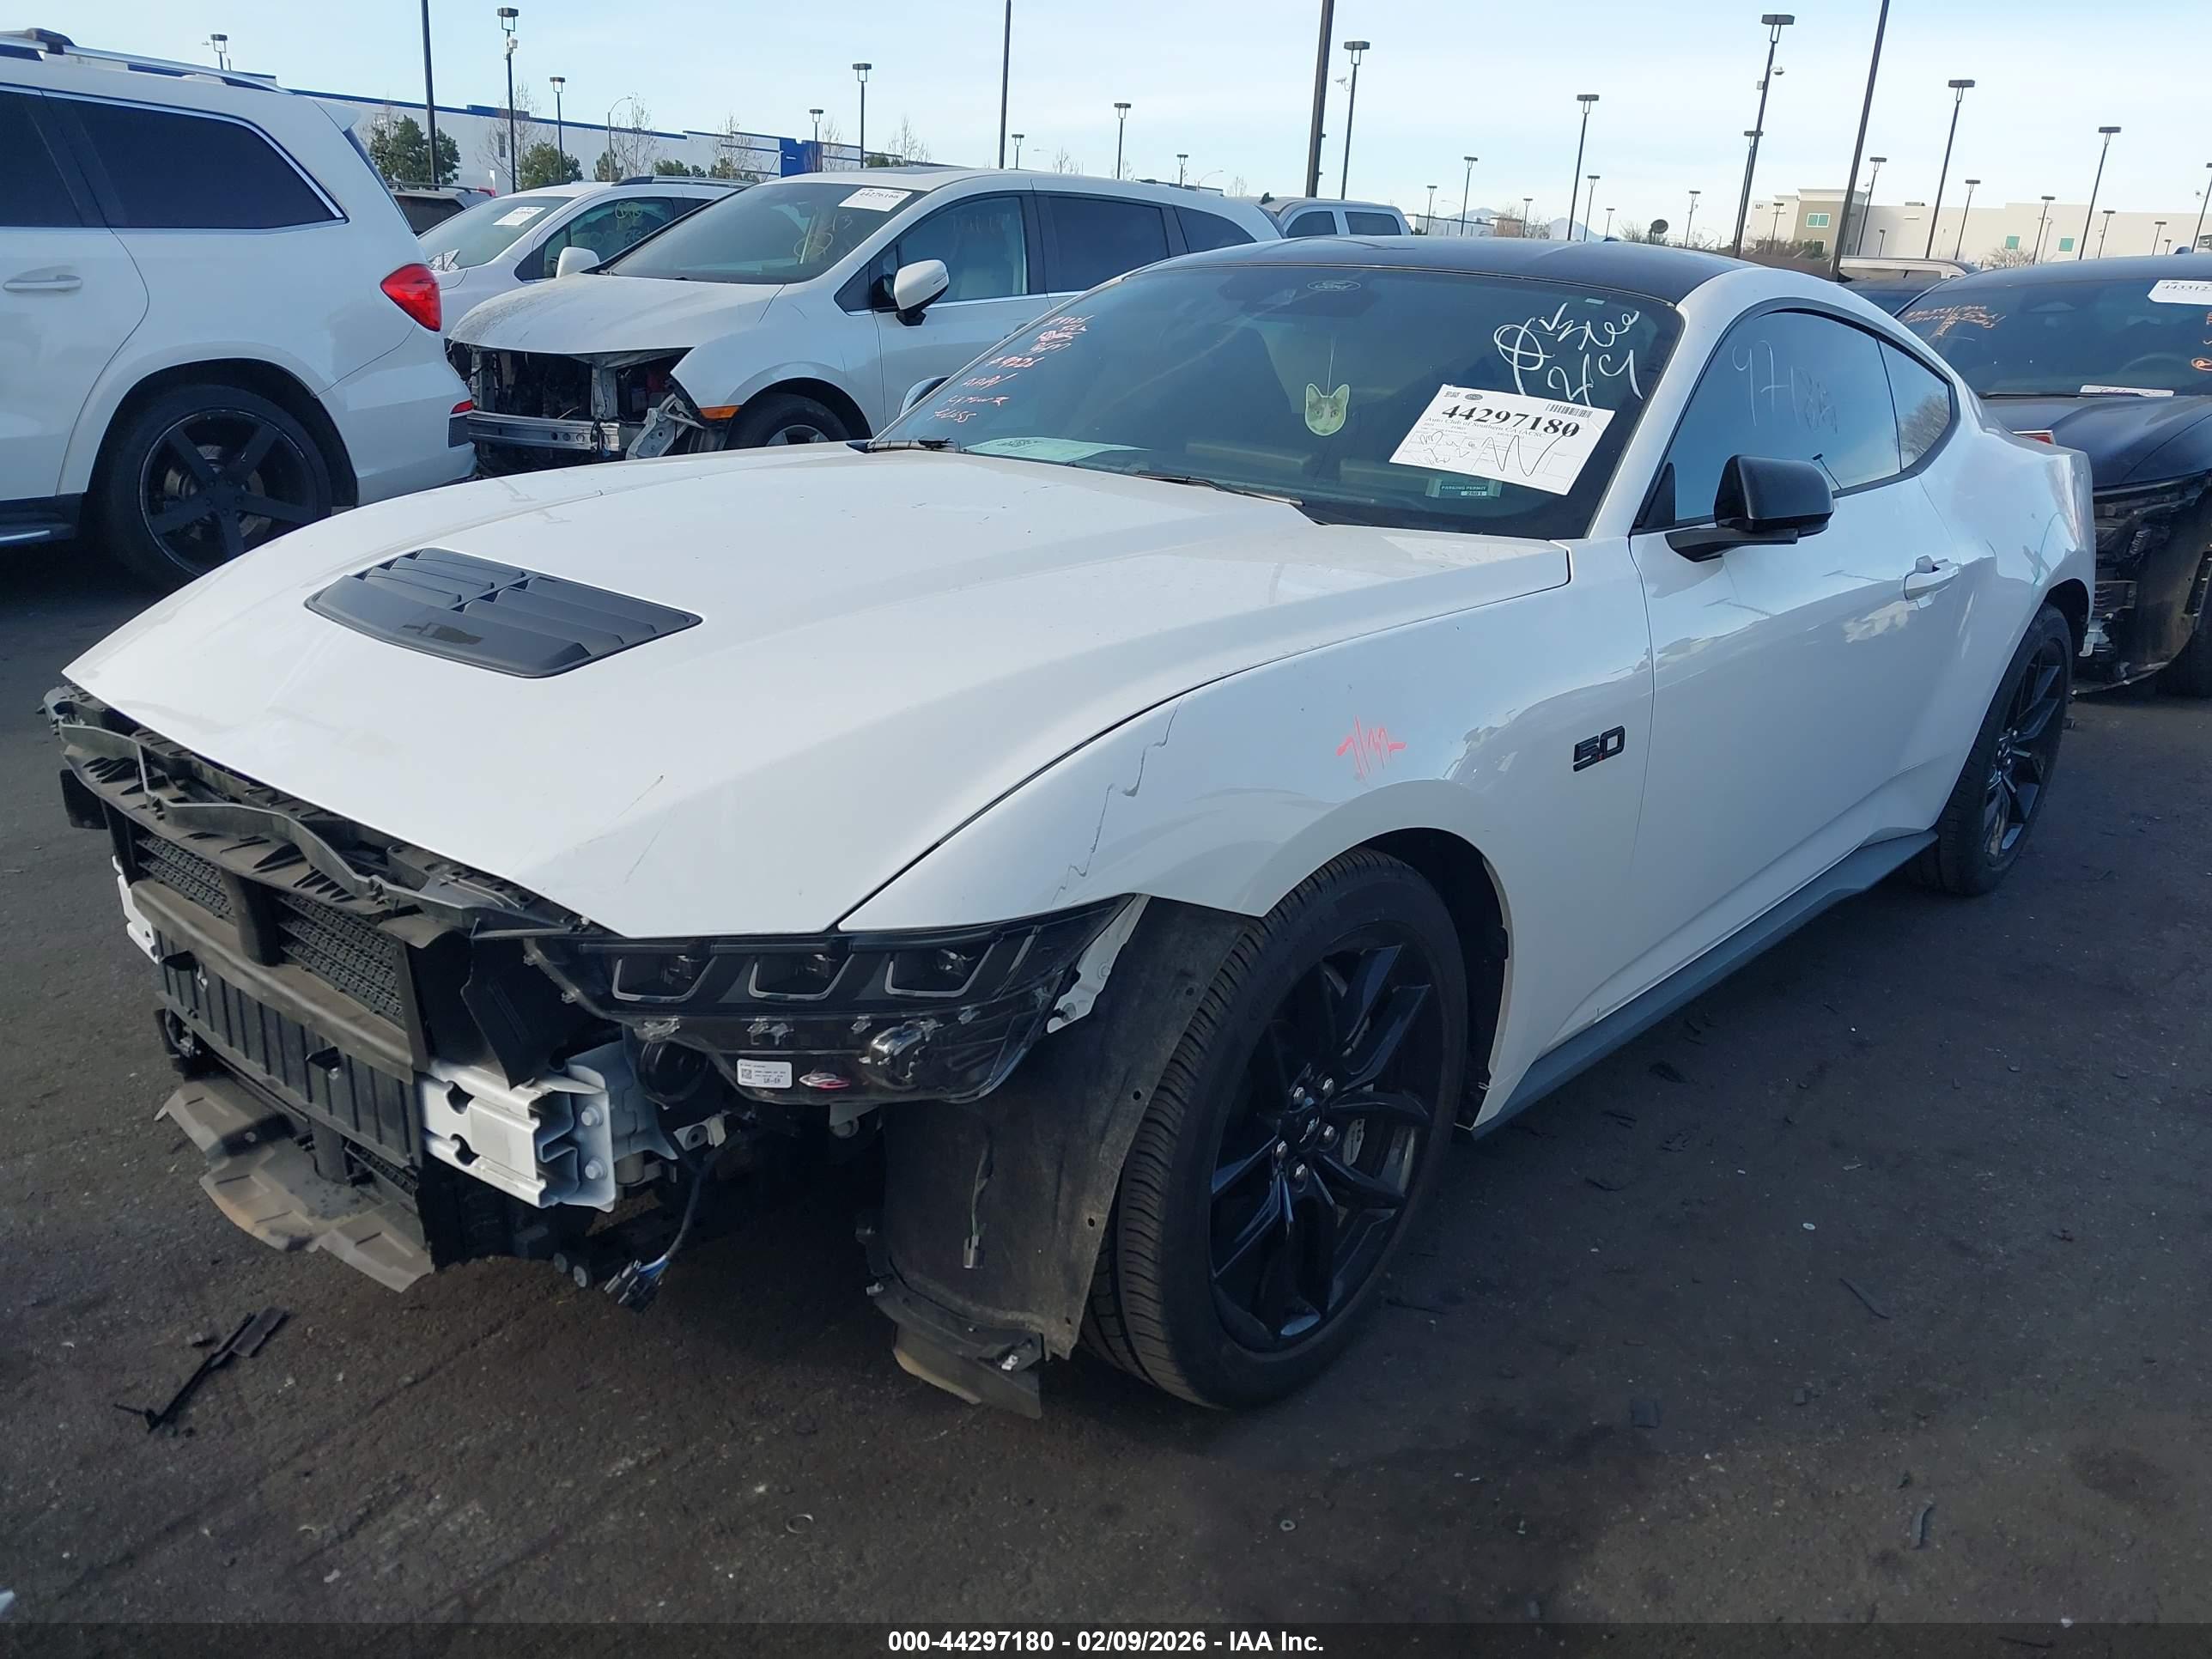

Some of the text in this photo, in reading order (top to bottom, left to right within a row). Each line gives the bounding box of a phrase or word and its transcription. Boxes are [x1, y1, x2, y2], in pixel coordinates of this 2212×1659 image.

[1442, 404, 1580, 437] 44297180
[1472, 422, 1504, 431] Southern
[1572, 725, 1626, 773] 5.0
